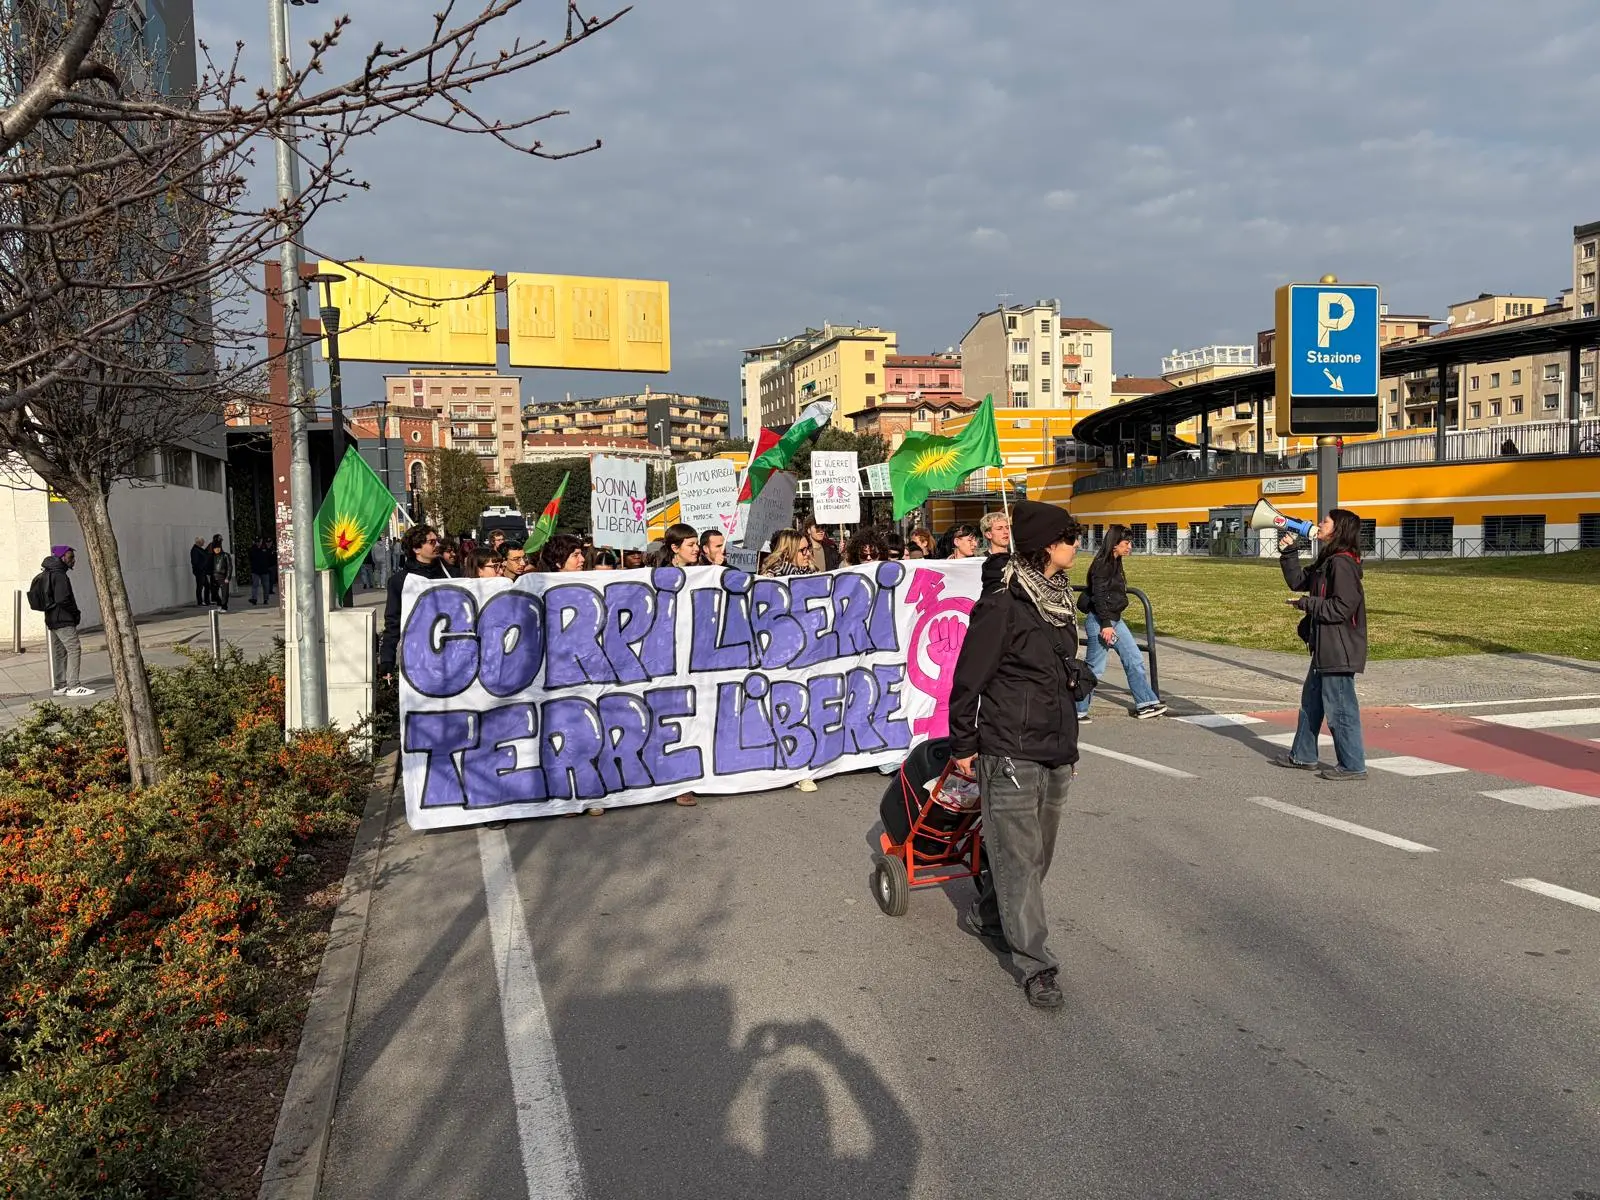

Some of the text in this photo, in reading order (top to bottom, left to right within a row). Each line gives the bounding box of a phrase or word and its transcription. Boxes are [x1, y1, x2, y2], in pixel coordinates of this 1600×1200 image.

[1317, 292, 1355, 348] P
[1306, 350, 1361, 364] Stazione
[814, 459, 822, 468] LE
[828, 469, 836, 477] LE
[678, 465, 710, 486] SIAMO
[595, 476, 637, 497] DONNA
[680, 487, 702, 499] SIAMO
[597, 497, 629, 514] VITA
[400, 560, 906, 697] CORPI LIBERI
[404, 662, 914, 809] TERRE LIBERE
